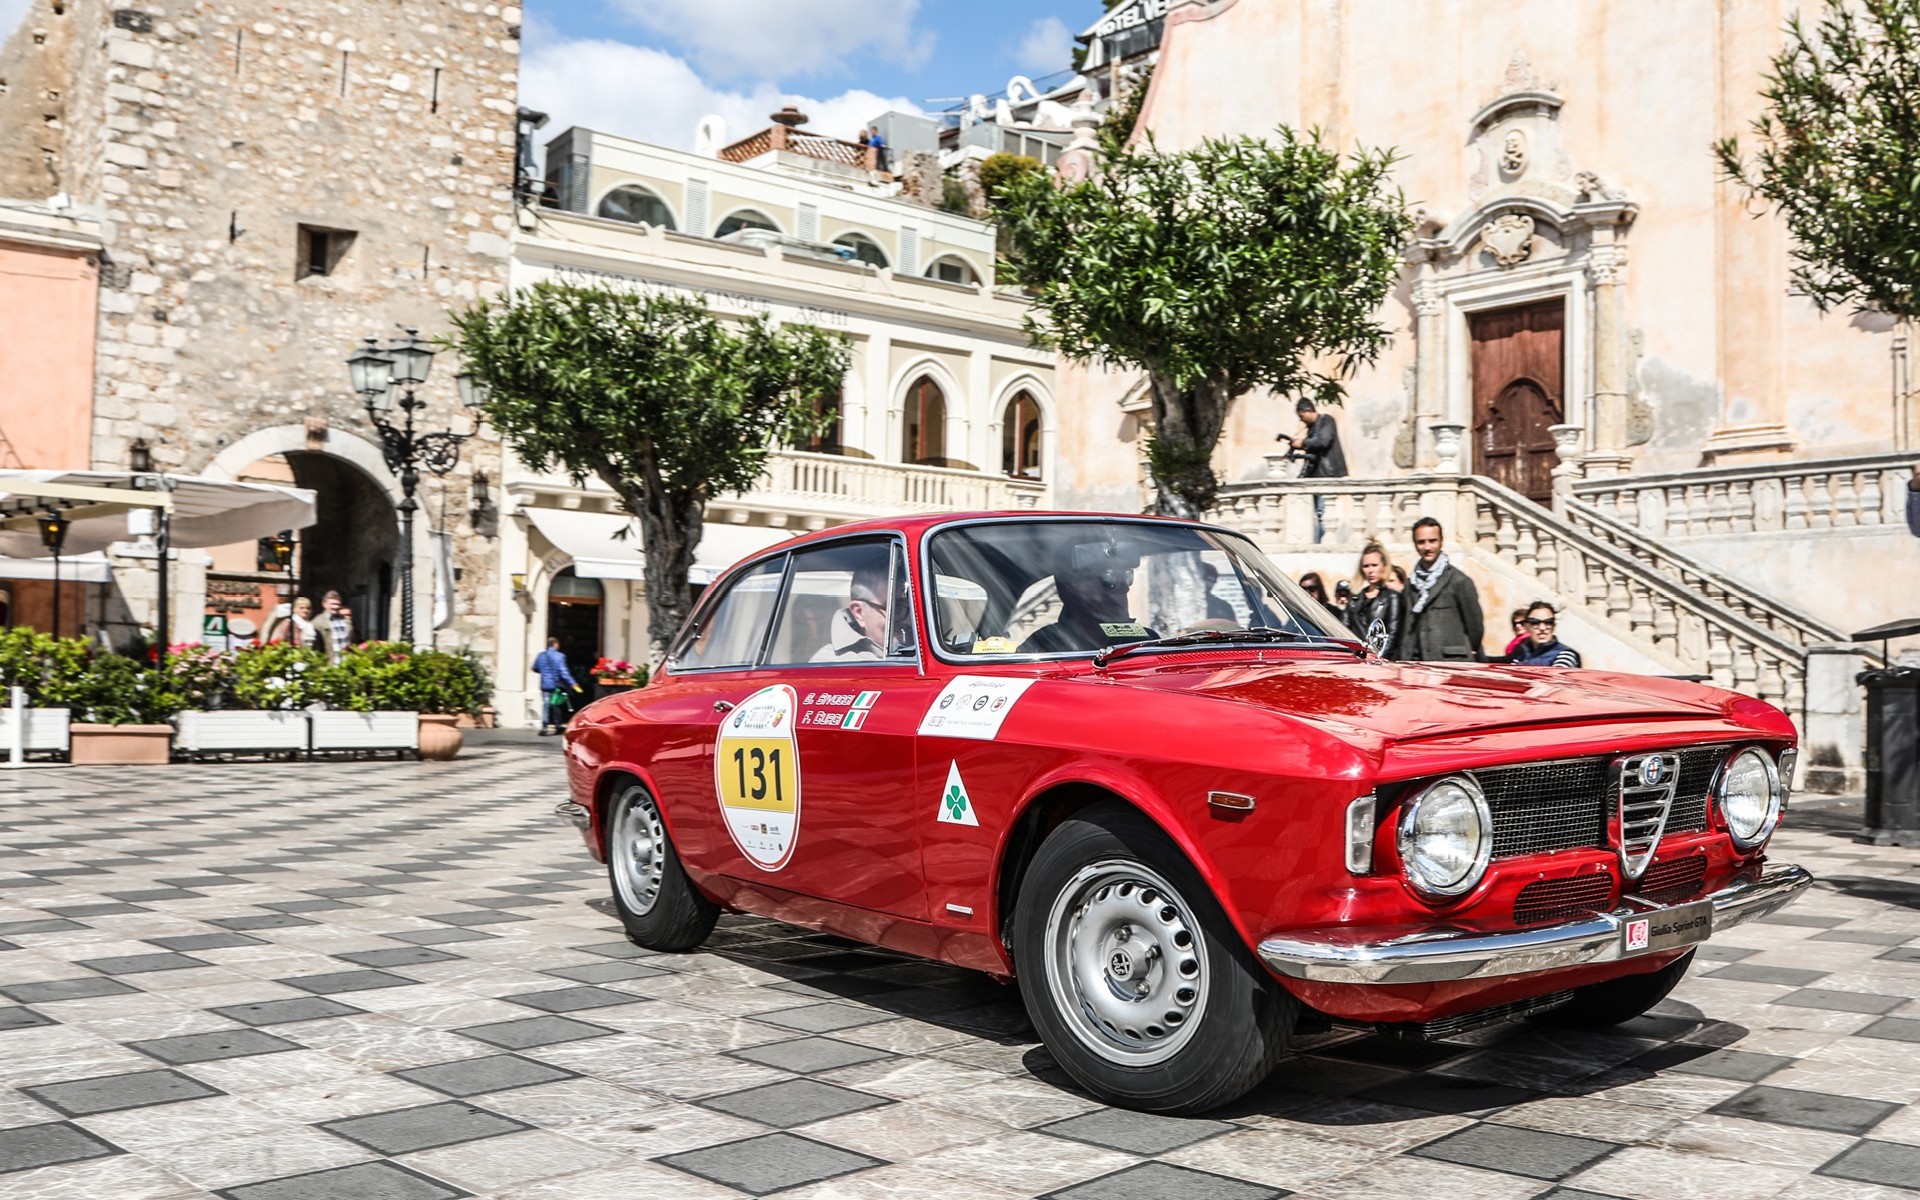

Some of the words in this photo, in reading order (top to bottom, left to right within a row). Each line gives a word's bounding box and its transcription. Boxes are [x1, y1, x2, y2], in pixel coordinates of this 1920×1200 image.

[1095, 6, 1146, 37] HOTEL
[795, 306, 849, 326] ARCHI
[801, 710, 814, 724] F.
[733, 747, 783, 801] 131
[1651, 925, 1671, 937] Giulia
[1673, 921, 1695, 935] Sprint
[1695, 916, 1707, 927] GTA
